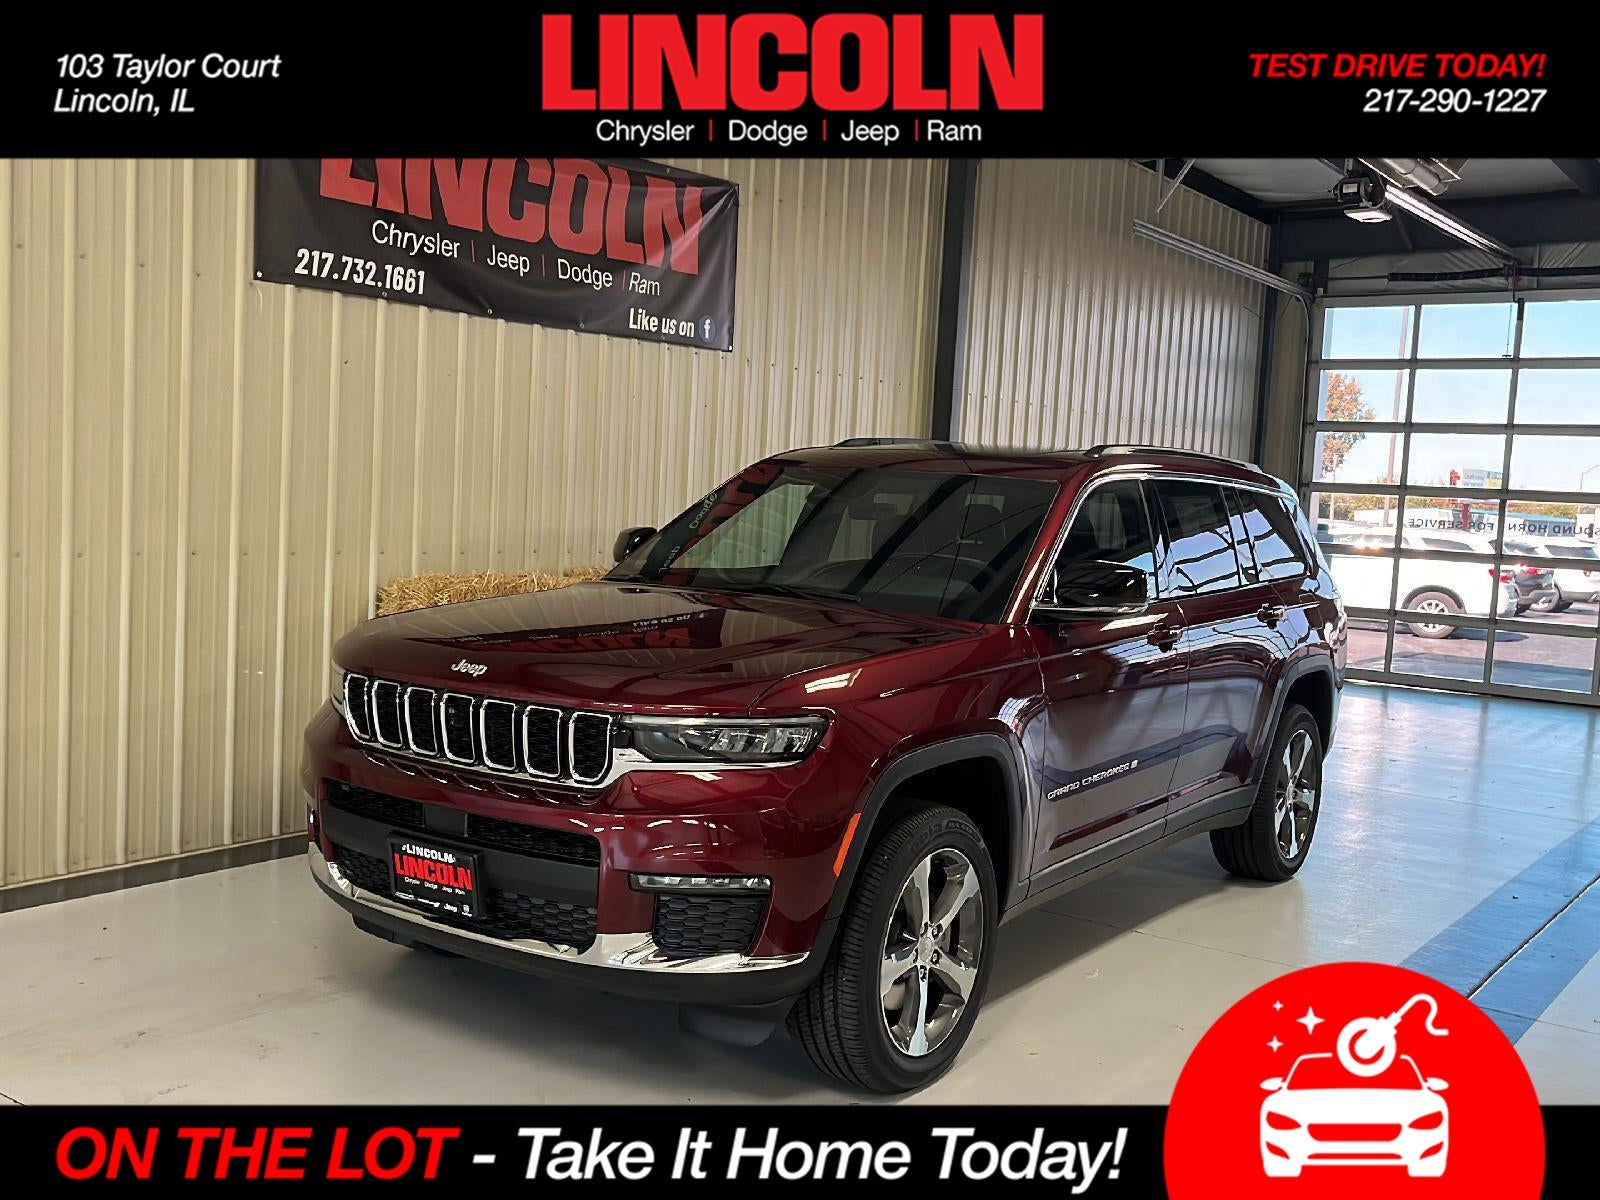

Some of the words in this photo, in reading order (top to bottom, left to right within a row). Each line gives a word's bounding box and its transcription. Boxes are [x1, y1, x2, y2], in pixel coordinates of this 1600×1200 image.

[294, 248, 425, 295] 217.732.1661
[371, 219, 460, 259] Chrysler
[487, 245, 530, 277] Jeep
[557, 258, 613, 291] Dodge
[628, 272, 661, 296] Ram
[629, 308, 658, 333] Like
[661, 317, 676, 335] us
[678, 320, 695, 338] on
[450, 659, 488, 677] Jeep
[1047, 781, 1080, 800] GRAND
[1081, 762, 1130, 786] CHEROKEE
[394, 853, 473, 891] LINCOLN
[406, 844, 454, 863] LINCOLN
